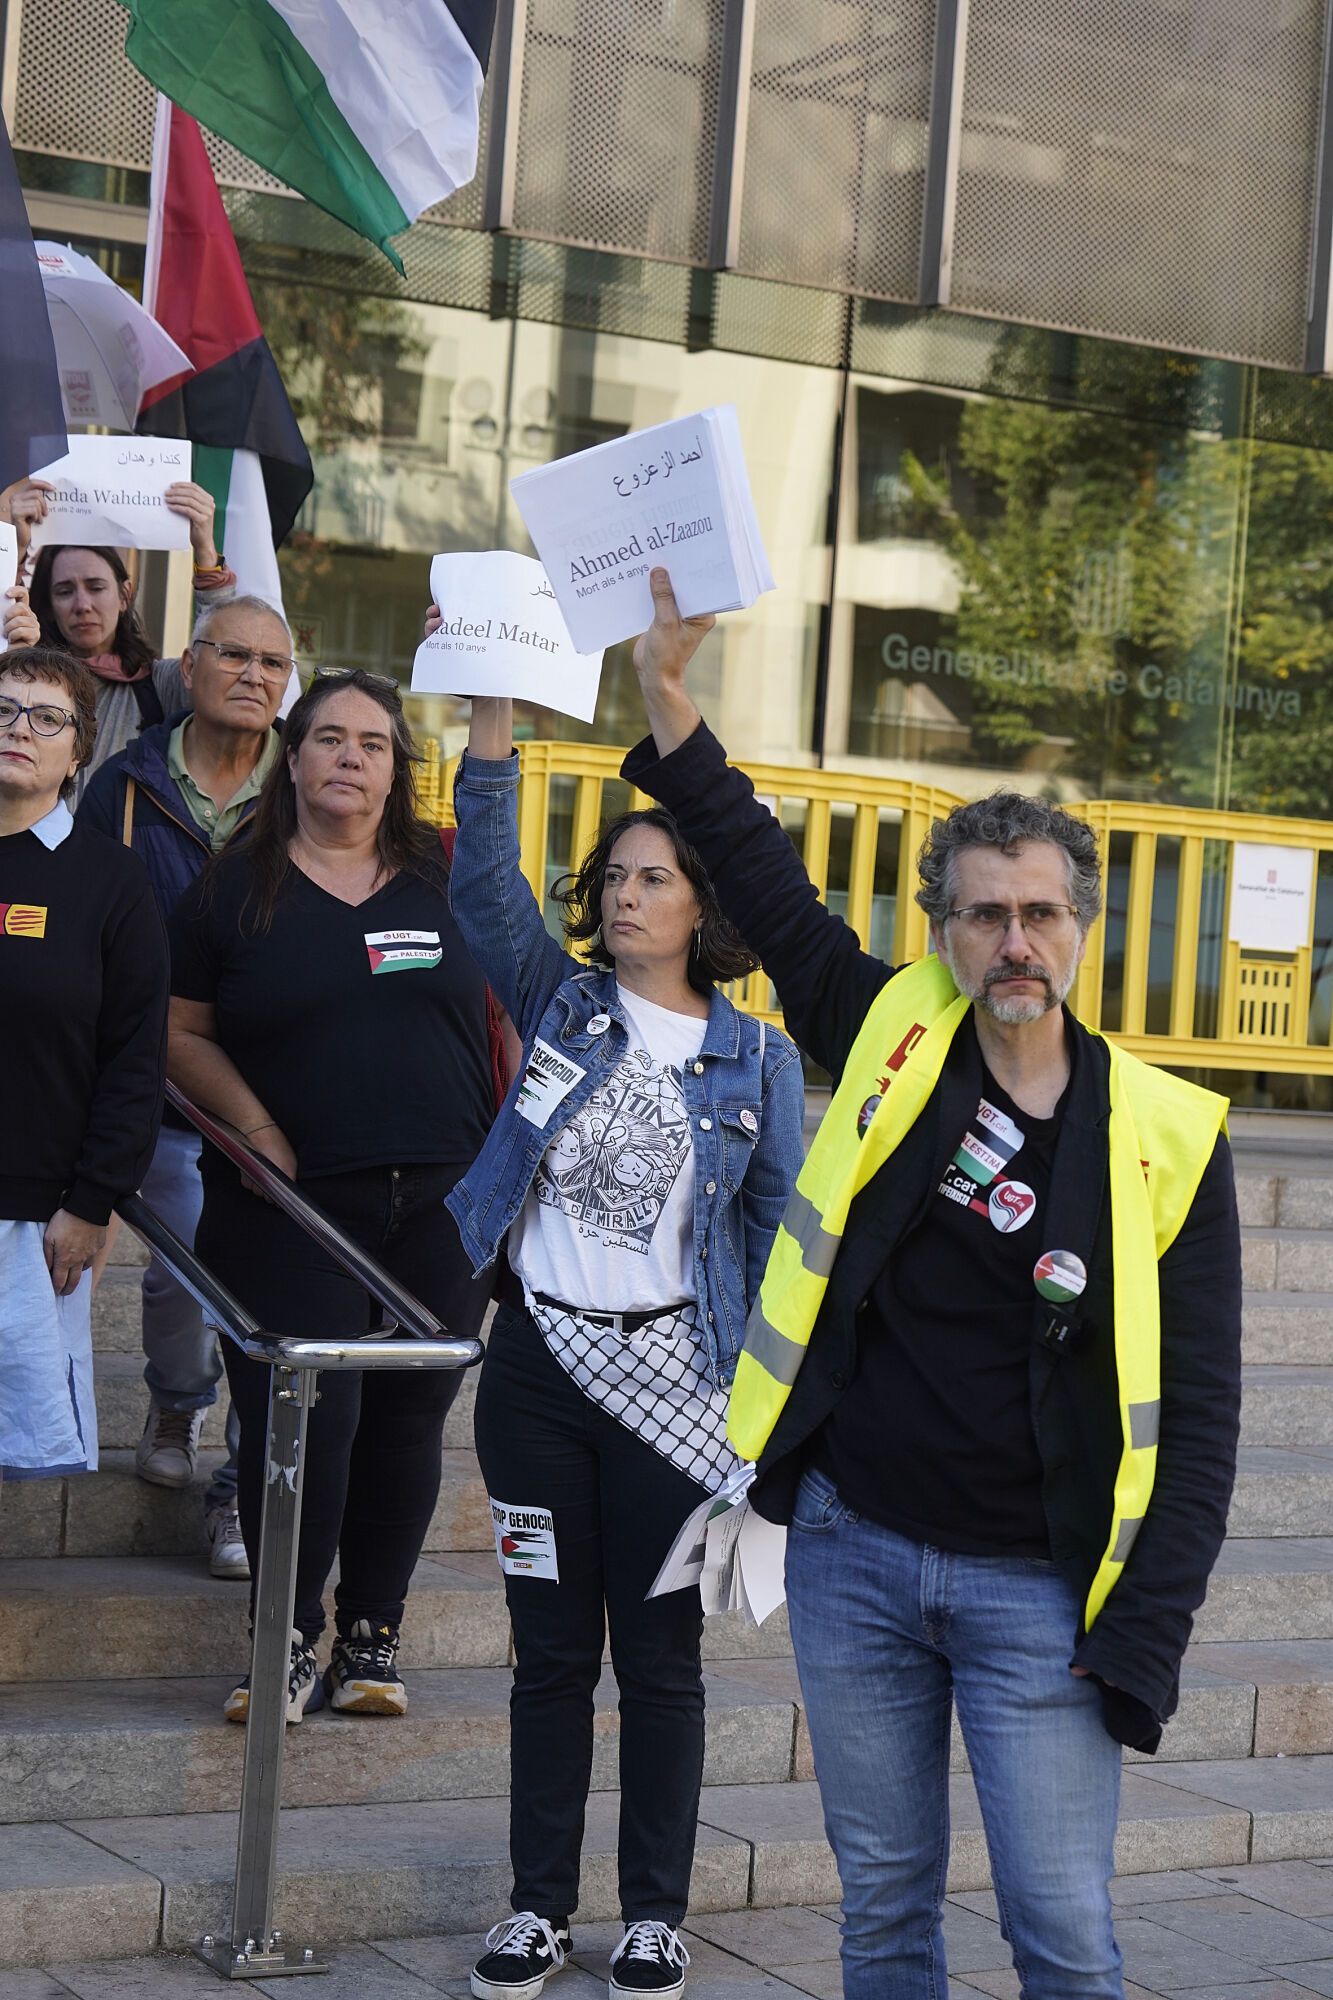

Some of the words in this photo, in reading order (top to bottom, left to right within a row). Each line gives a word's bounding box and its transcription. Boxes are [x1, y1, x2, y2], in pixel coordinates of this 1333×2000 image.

[159, 453, 181, 465] كندا
[680, 435, 704, 465] أحمد
[612, 450, 676, 497] الزعزوع
[48, 506, 56, 514] ort
[93, 489, 162, 507] Wahdan
[569, 535, 645, 583] Ahmed
[646, 516, 714, 551] al-Zaazou
[529, 580, 557, 599] طر
[576, 581, 600, 599] Mort
[602, 576, 616, 589] als
[617, 572, 625, 581] 4
[627, 563, 650, 579] anys
[425, 641, 439, 650] Mort
[441, 642, 452, 650] als
[455, 642, 464, 651] 10
[466, 644, 487, 654] anys
[434, 617, 492, 639] adeel
[497, 622, 560, 654] Matar
[1137, 664, 1300, 721] Catalunya
[400, 950, 441, 958] PALESTINA
[532, 1047, 578, 1086] GENOCIDI
[589, 1088, 687, 1151] ESTINA
[963, 1136, 1002, 1170] LESTINA
[943, 1164, 978, 1196] T.cat
[596, 1202, 653, 1229] MIRALL
[578, 1223, 600, 1239] حرة
[602, 1234, 649, 1256] فلسطين
[508, 1511, 553, 1532] GENOCID
